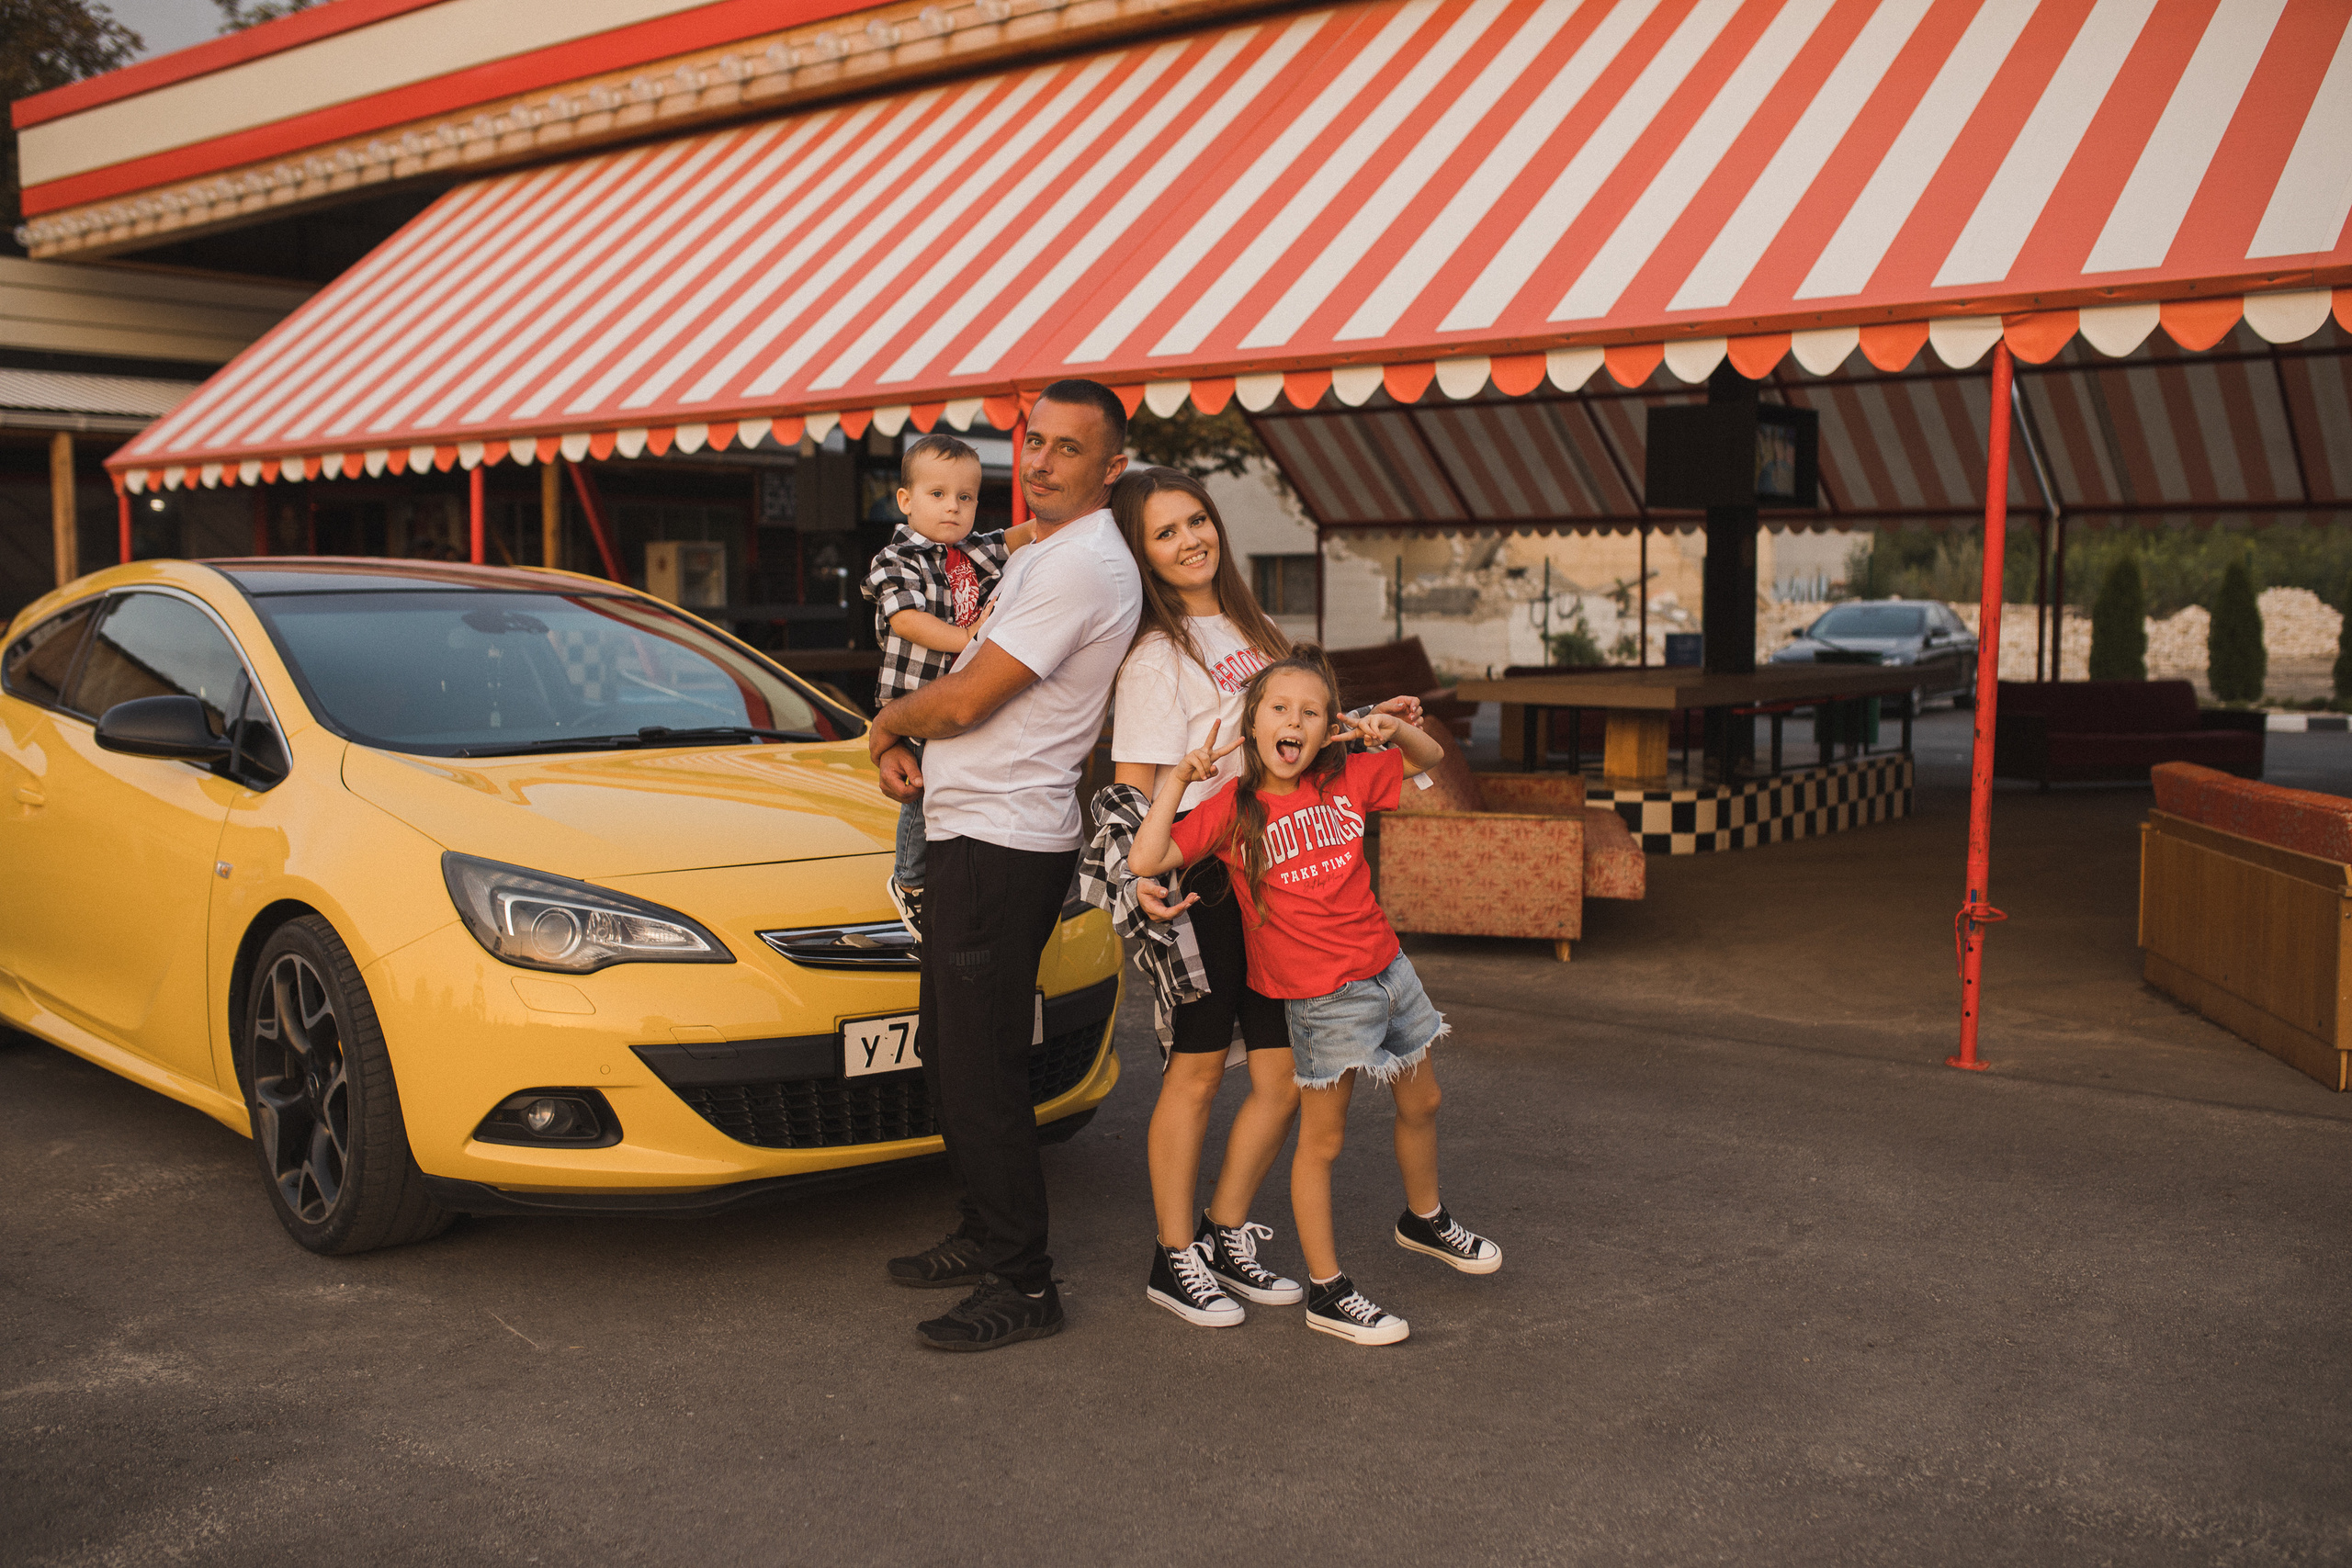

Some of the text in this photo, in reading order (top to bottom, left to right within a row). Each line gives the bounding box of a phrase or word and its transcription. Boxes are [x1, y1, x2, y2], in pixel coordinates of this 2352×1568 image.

[1294, 795, 1365, 852] THINGS
[1281, 864, 1318, 885] TAKE
[1321, 851, 1352, 873] TIME
